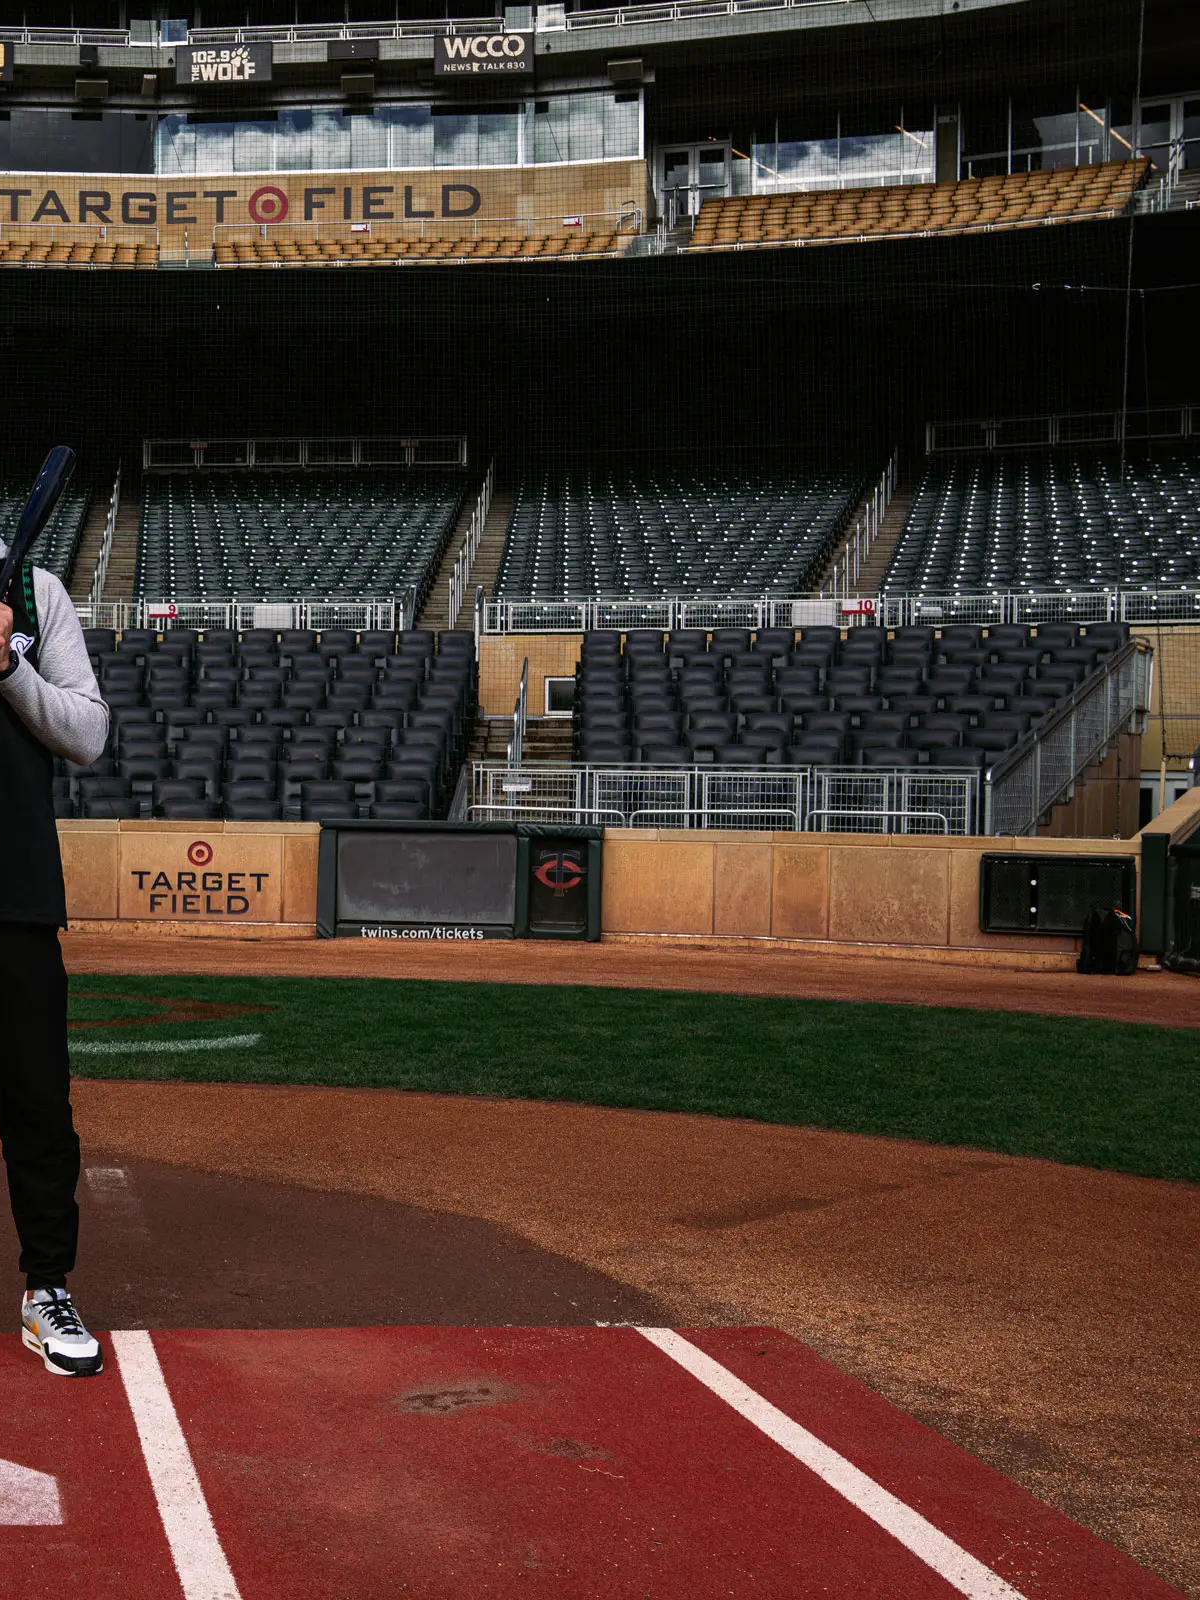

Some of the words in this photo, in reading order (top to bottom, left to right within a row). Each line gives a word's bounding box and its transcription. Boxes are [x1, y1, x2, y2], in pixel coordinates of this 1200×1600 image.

[443, 35, 525, 58] WCCO
[191, 50, 230, 64] 102.9
[191, 64, 200, 82] THE
[200, 62, 256, 81] WOLF
[443, 63, 472, 72] NEWS
[482, 62, 505, 70] TALK
[506, 61, 525, 69] 830
[304, 184, 482, 221] FIELD
[168, 604, 177, 616] 9
[856, 600, 873, 611] 10
[131, 871, 269, 892] TARGET
[149, 894, 250, 915] FIELD
[360, 926, 484, 939] twins.com/tickets
